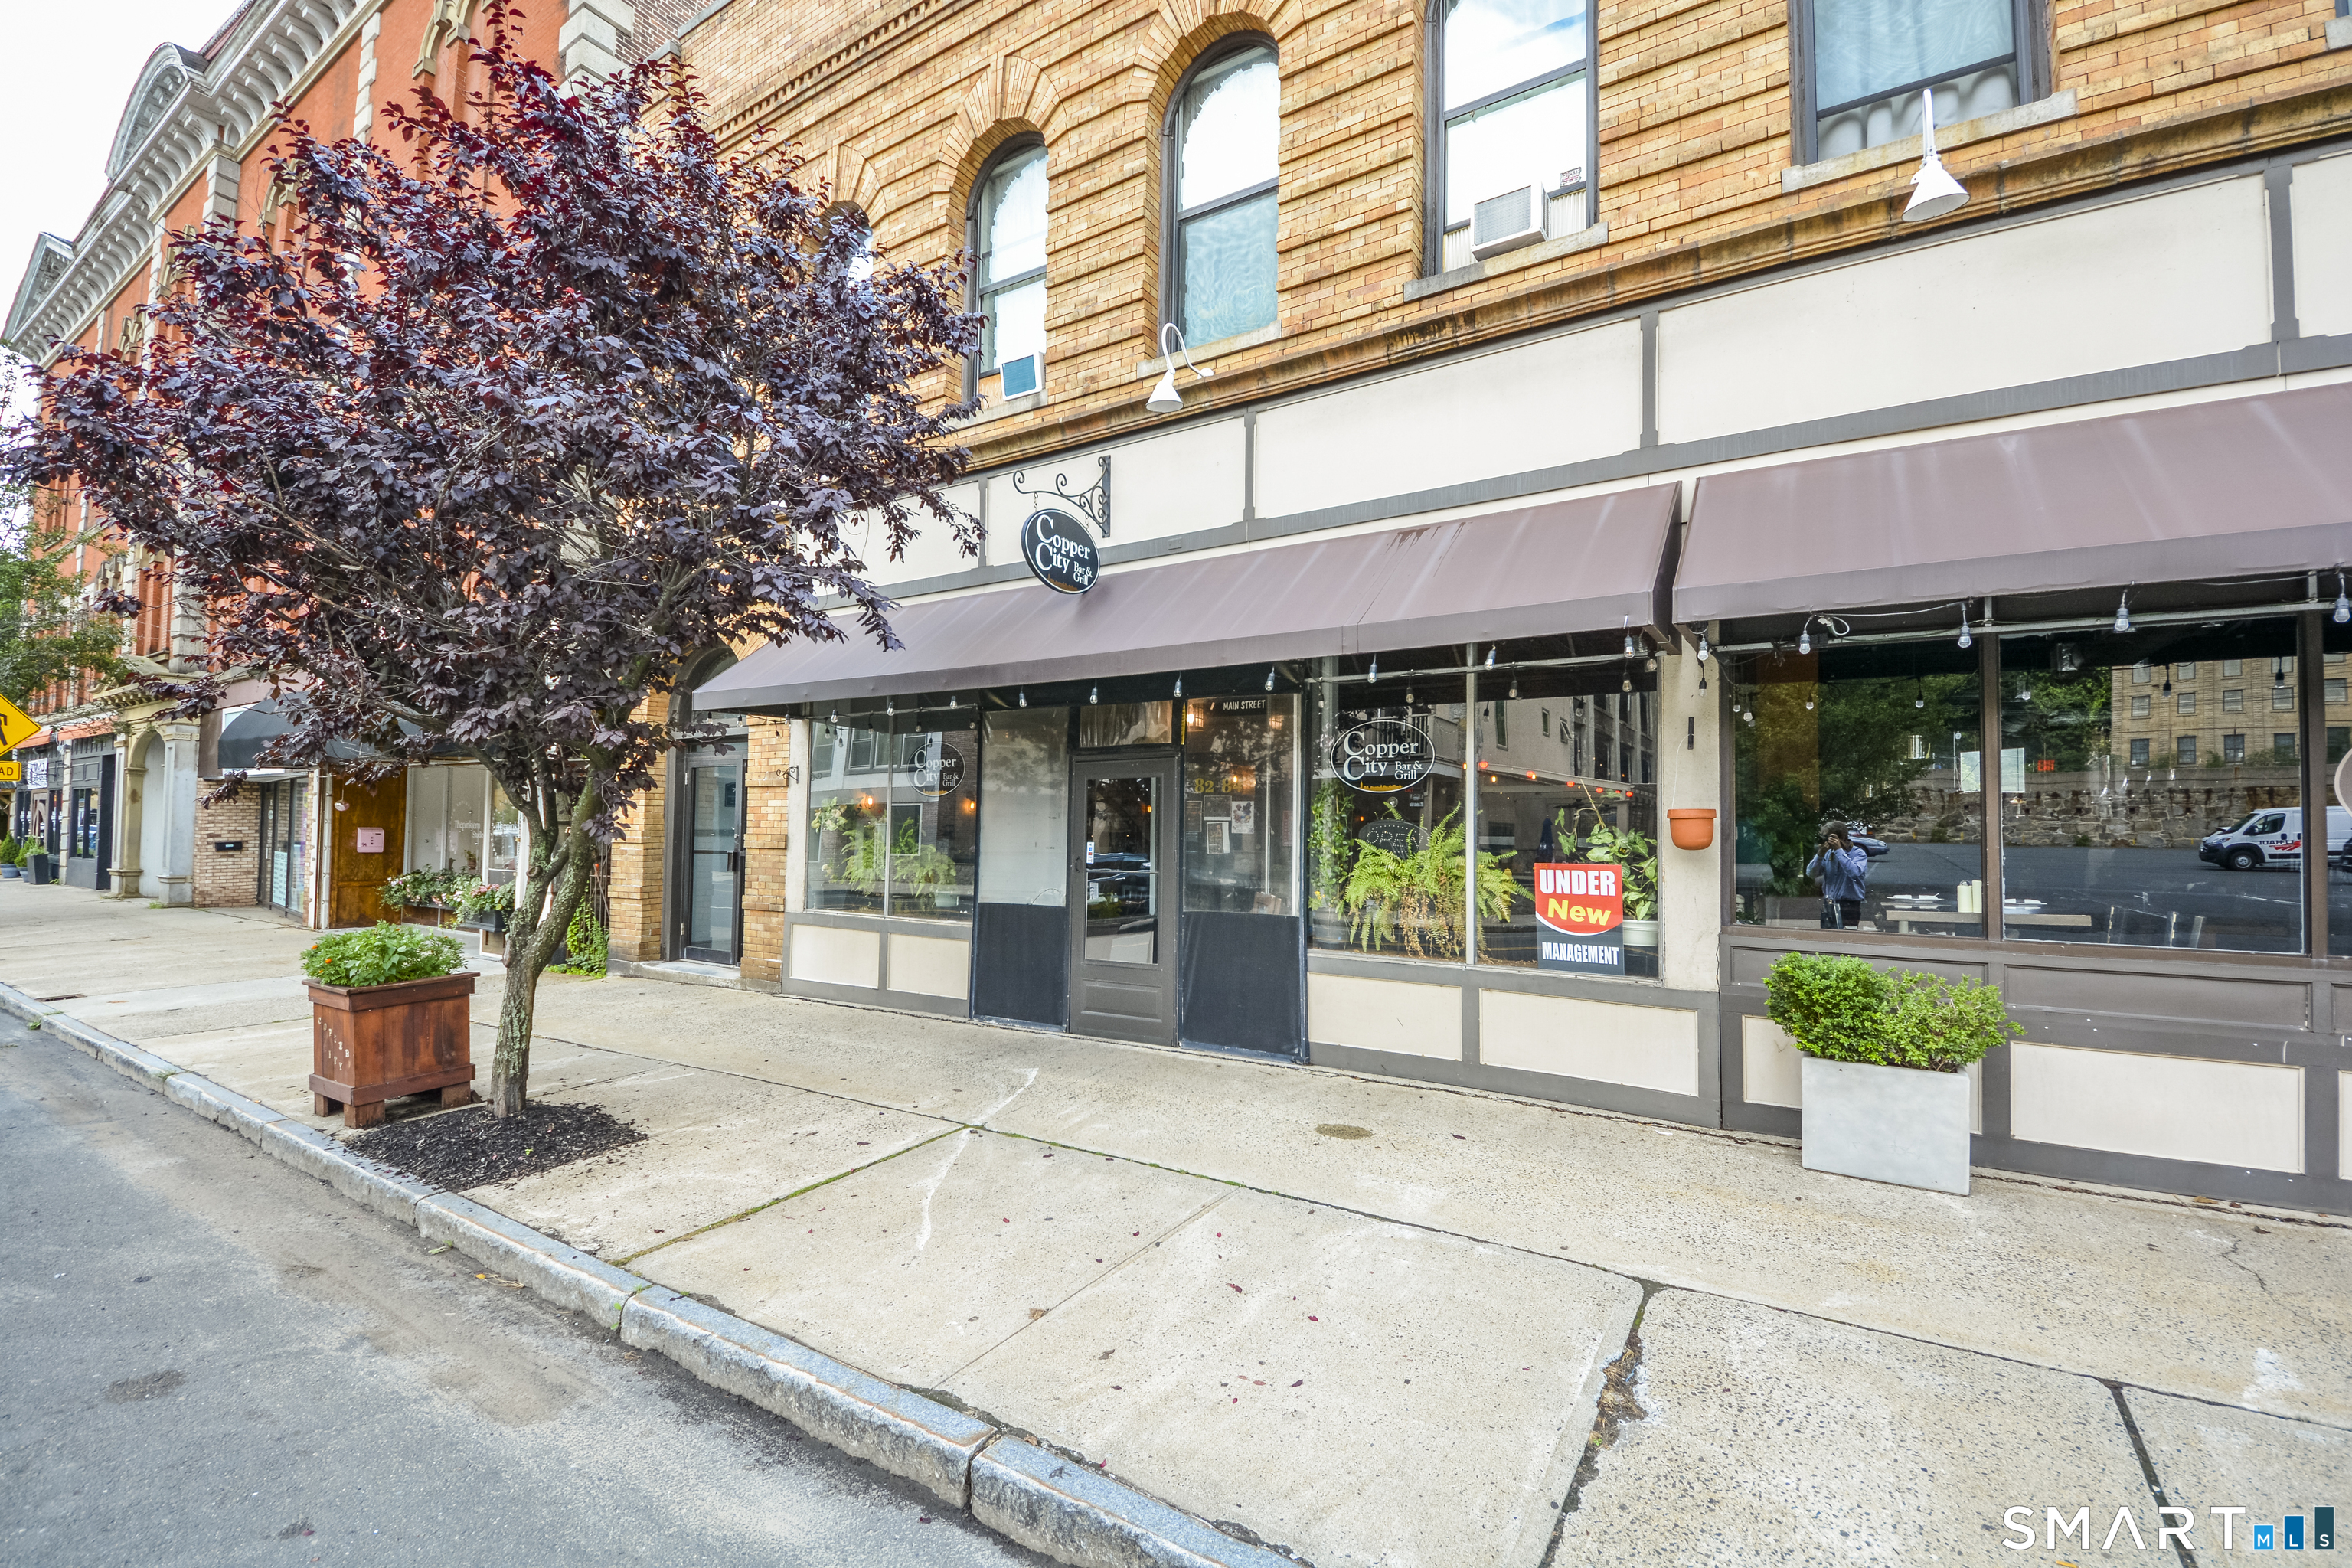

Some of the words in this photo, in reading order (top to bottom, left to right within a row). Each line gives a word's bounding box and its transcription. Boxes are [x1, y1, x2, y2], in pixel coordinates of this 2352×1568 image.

[1036, 514, 1091, 560] Copper
[1035, 542, 1070, 573] City
[1073, 561, 1085, 574] Bar
[1086, 567, 1093, 578] &
[1073, 572, 1089, 586] Grill
[1223, 701, 1240, 710] MAIN
[1240, 699, 1266, 710] STREET
[1343, 730, 1419, 759] Copper
[914, 750, 957, 771] Copper
[1343, 755, 1388, 781] City
[1395, 760, 1411, 771] Bar
[1413, 760, 1424, 770] &
[913, 768, 939, 788] City
[1394, 769, 1417, 780] Grill
[1539, 869, 1616, 897] UNDER
[1547, 897, 1612, 926] New
[1541, 942, 1620, 965] MANAGEMENT
